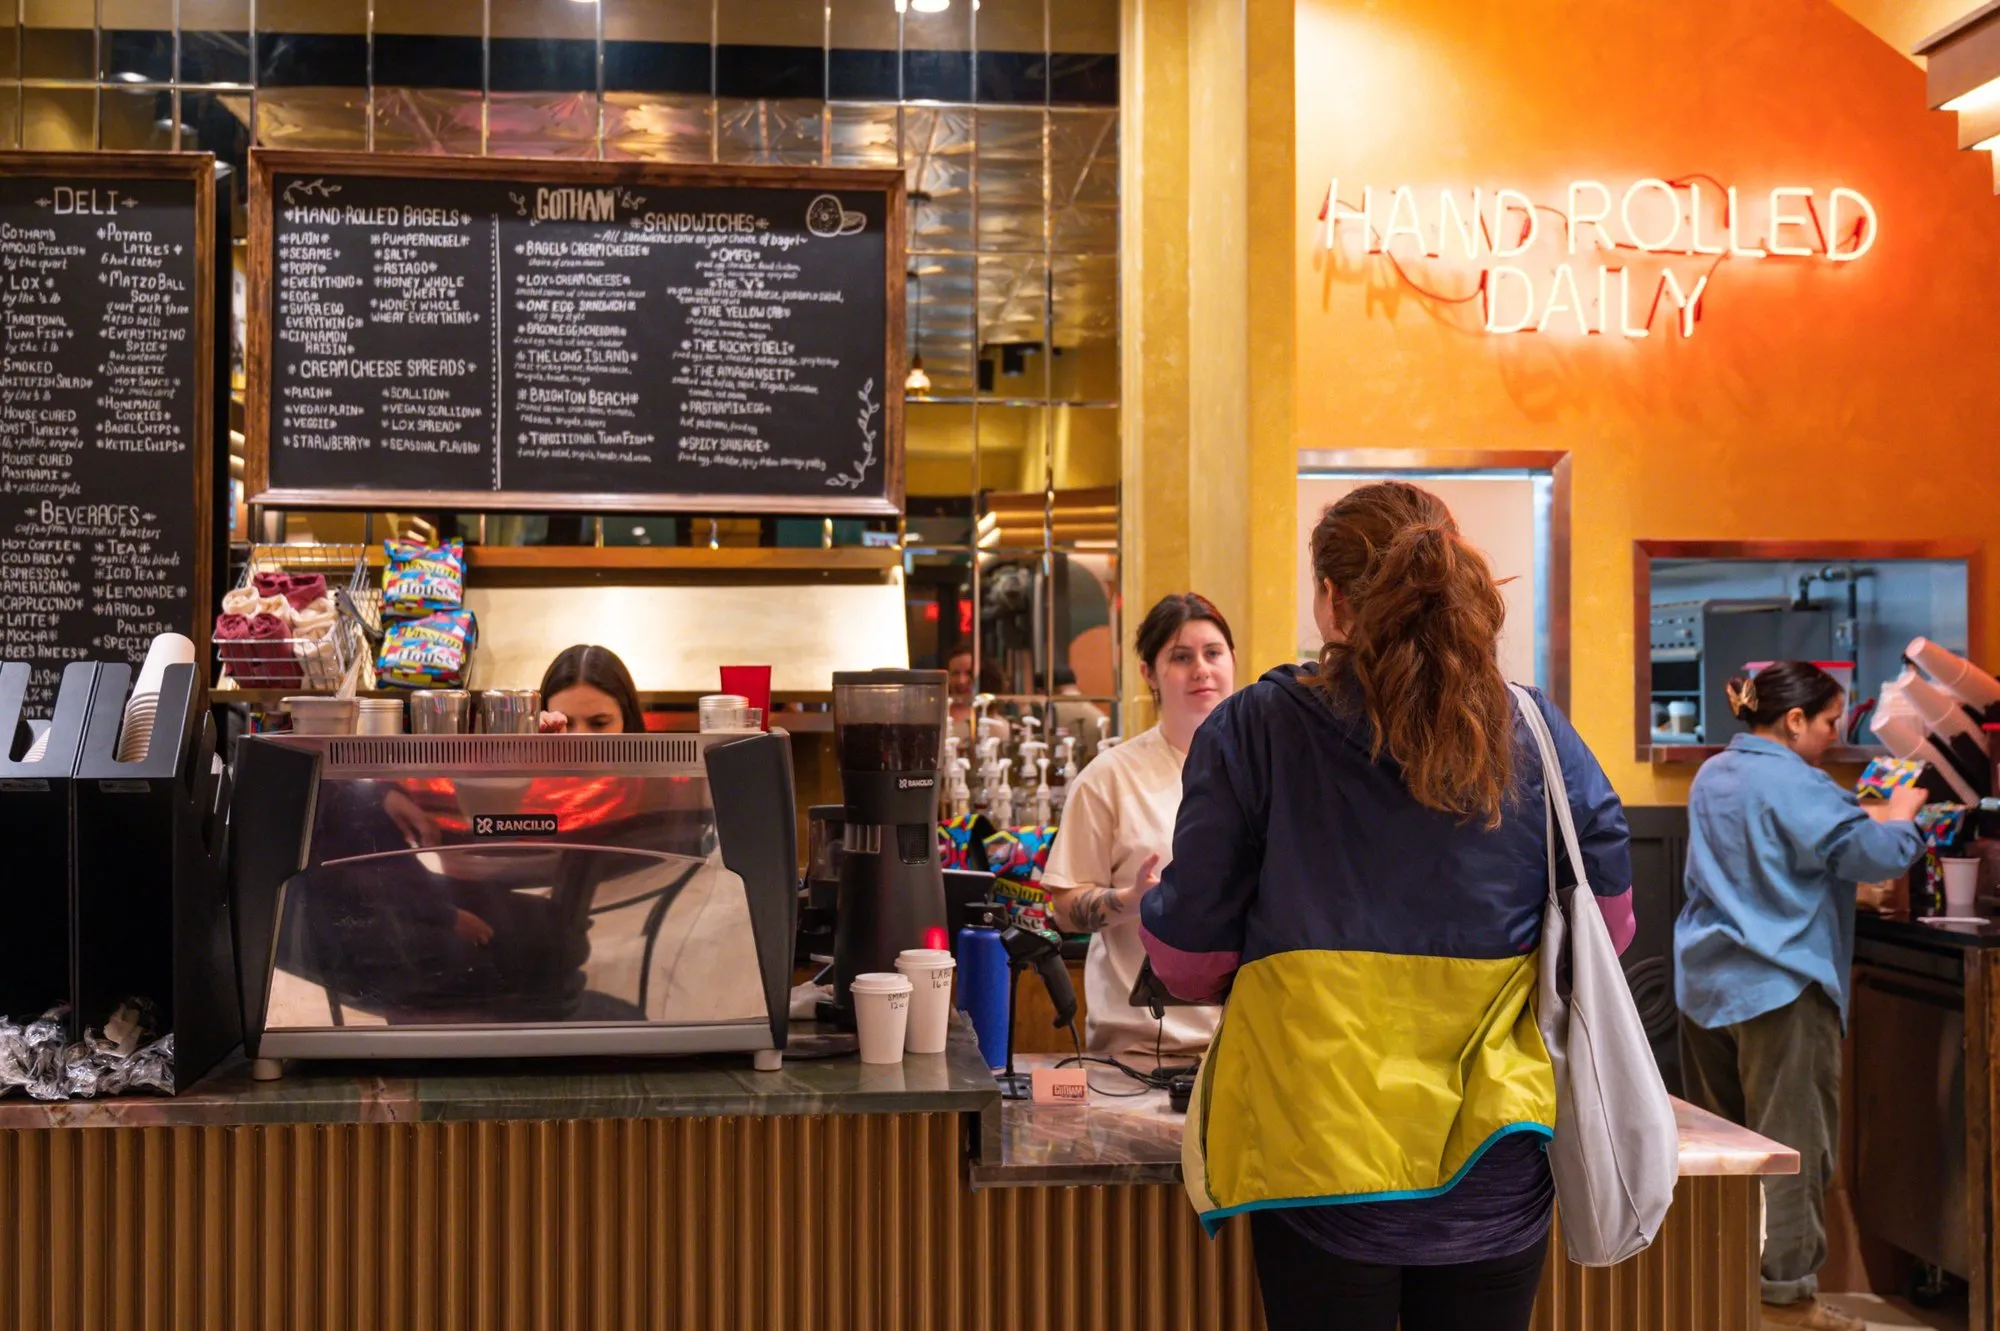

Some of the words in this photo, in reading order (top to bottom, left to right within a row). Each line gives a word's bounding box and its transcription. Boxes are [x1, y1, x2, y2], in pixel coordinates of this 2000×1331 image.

[54, 186, 118, 215] DELI
[537, 187, 615, 222] GOTHAM
[403, 205, 459, 227] BAGELS
[644, 212, 755, 233] SANDWICHES
[1326, 178, 1539, 258] HAND
[1567, 178, 1877, 261] ROLLED
[107, 221, 152, 242] POTATO
[290, 231, 320, 246] PLAIN
[382, 231, 461, 248] PUMPERNICKEL
[38, 241, 79, 256] PICKLES
[123, 240, 169, 256] LATKES
[290, 247, 333, 260] SESAME
[384, 248, 409, 261] SALT
[526, 240, 560, 257] BAGEL
[571, 242, 605, 257] CREAM
[606, 244, 640, 257] CHEESE
[719, 248, 752, 263] OMFG
[19, 256, 37, 269] the
[290, 261, 318, 275] POPPY
[11, 274, 40, 290] LOX
[109, 270, 157, 290] MATZO
[158, 272, 186, 292] BALL
[290, 275, 355, 289] EVERYTHING
[384, 276, 420, 289] HONEY
[424, 276, 464, 288] WHOLE
[526, 275, 549, 286] LOX
[555, 273, 585, 285] CREAM
[587, 273, 623, 287] CHEESE
[716, 278, 738, 291] THE
[131, 289, 160, 303] SOUP
[289, 290, 310, 302] EGG
[403, 287, 446, 299] WHEAT
[1485, 263, 1707, 337] DAILY
[290, 302, 322, 316] SUPER
[323, 302, 344, 316] EGG
[380, 298, 417, 311] HONEY
[420, 299, 460, 311] WHOLE
[526, 300, 550, 312] ONE
[552, 300, 575, 312] EGG
[579, 300, 627, 312] SANDWICH
[702, 306, 722, 317] THE
[726, 306, 765, 318] YELLOW
[286, 315, 355, 329] EVERYTHING
[371, 311, 404, 323] WHEAT
[408, 310, 472, 324] EVERYTHING
[5, 325, 35, 340] TUNA
[37, 325, 64, 340] FISH
[108, 326, 186, 341] EVERYTHING
[288, 329, 347, 343] CINNAMON
[126, 340, 158, 353] SPICE
[305, 341, 346, 356] RAISIN
[693, 339, 717, 351] THE
[761, 341, 788, 355] DELI
[528, 350, 551, 362] THE
[553, 350, 582, 362] LONG
[584, 348, 630, 363] ISLAND
[3, 357, 53, 374] SMOKED
[106, 360, 165, 377] SNAKEBITE
[300, 359, 348, 378] CREAM
[350, 358, 403, 379] CHEESE
[407, 358, 466, 377] SPREADS
[693, 365, 715, 378] THE
[717, 366, 790, 381] AMAGANSETT
[56, 372, 85, 389] SALAD
[115, 377, 137, 387] HOT
[292, 386, 324, 399] PLAIN
[391, 386, 444, 400] SCALLION
[529, 387, 587, 404] BRIGHTON
[588, 388, 629, 406] BEACH
[105, 394, 162, 411] HOMEMADE
[293, 403, 328, 415] VEGAN
[329, 404, 358, 416] PLAIN
[690, 401, 738, 415] PASTRAMI
[115, 409, 162, 422] COOKIES
[390, 404, 425, 415] VEGAN
[426, 405, 475, 418] SCALLION
[29, 421, 68, 436] TURKEY
[105, 420, 137, 435] BAGEL
[138, 420, 172, 436] CHIPS
[293, 417, 329, 429] VEGGIE
[391, 420, 415, 431] LOX
[417, 420, 455, 433] SPREAD
[292, 434, 363, 451] STRAWBERRY
[622, 430, 648, 444] FISH
[105, 437, 144, 453] KETTLE
[144, 437, 178, 453] CHIPS
[390, 438, 438, 453] SEASONAL
[689, 437, 718, 451] SPICY
[720, 438, 763, 453] SAUSAGE
[2, 465, 60, 480] PASTRAMI
[41, 500, 140, 526] BEVERAGES
[1, 538, 26, 550] HOT
[28, 538, 72, 551] COFFEE
[107, 539, 137, 555] TEA
[1, 552, 31, 563] COLD
[32, 552, 64, 565] BREW
[2, 566, 60, 581] ESPRESSO
[105, 565, 132, 581] ICED
[134, 565, 156, 581] TEA
[3, 580, 74, 594] AMERICANO
[105, 582, 176, 600] LEMONADE
[2, 596, 77, 612] CAPPUCCINO
[105, 602, 156, 617] ARNOLD
[7, 613, 46, 627] LATTE
[117, 618, 164, 635] PALMER
[7, 629, 48, 643] MOCHA
[37, 646, 77, 660] KNEES
[496, 819, 556, 831] RANCILIO
[932, 981, 942, 989] 16
